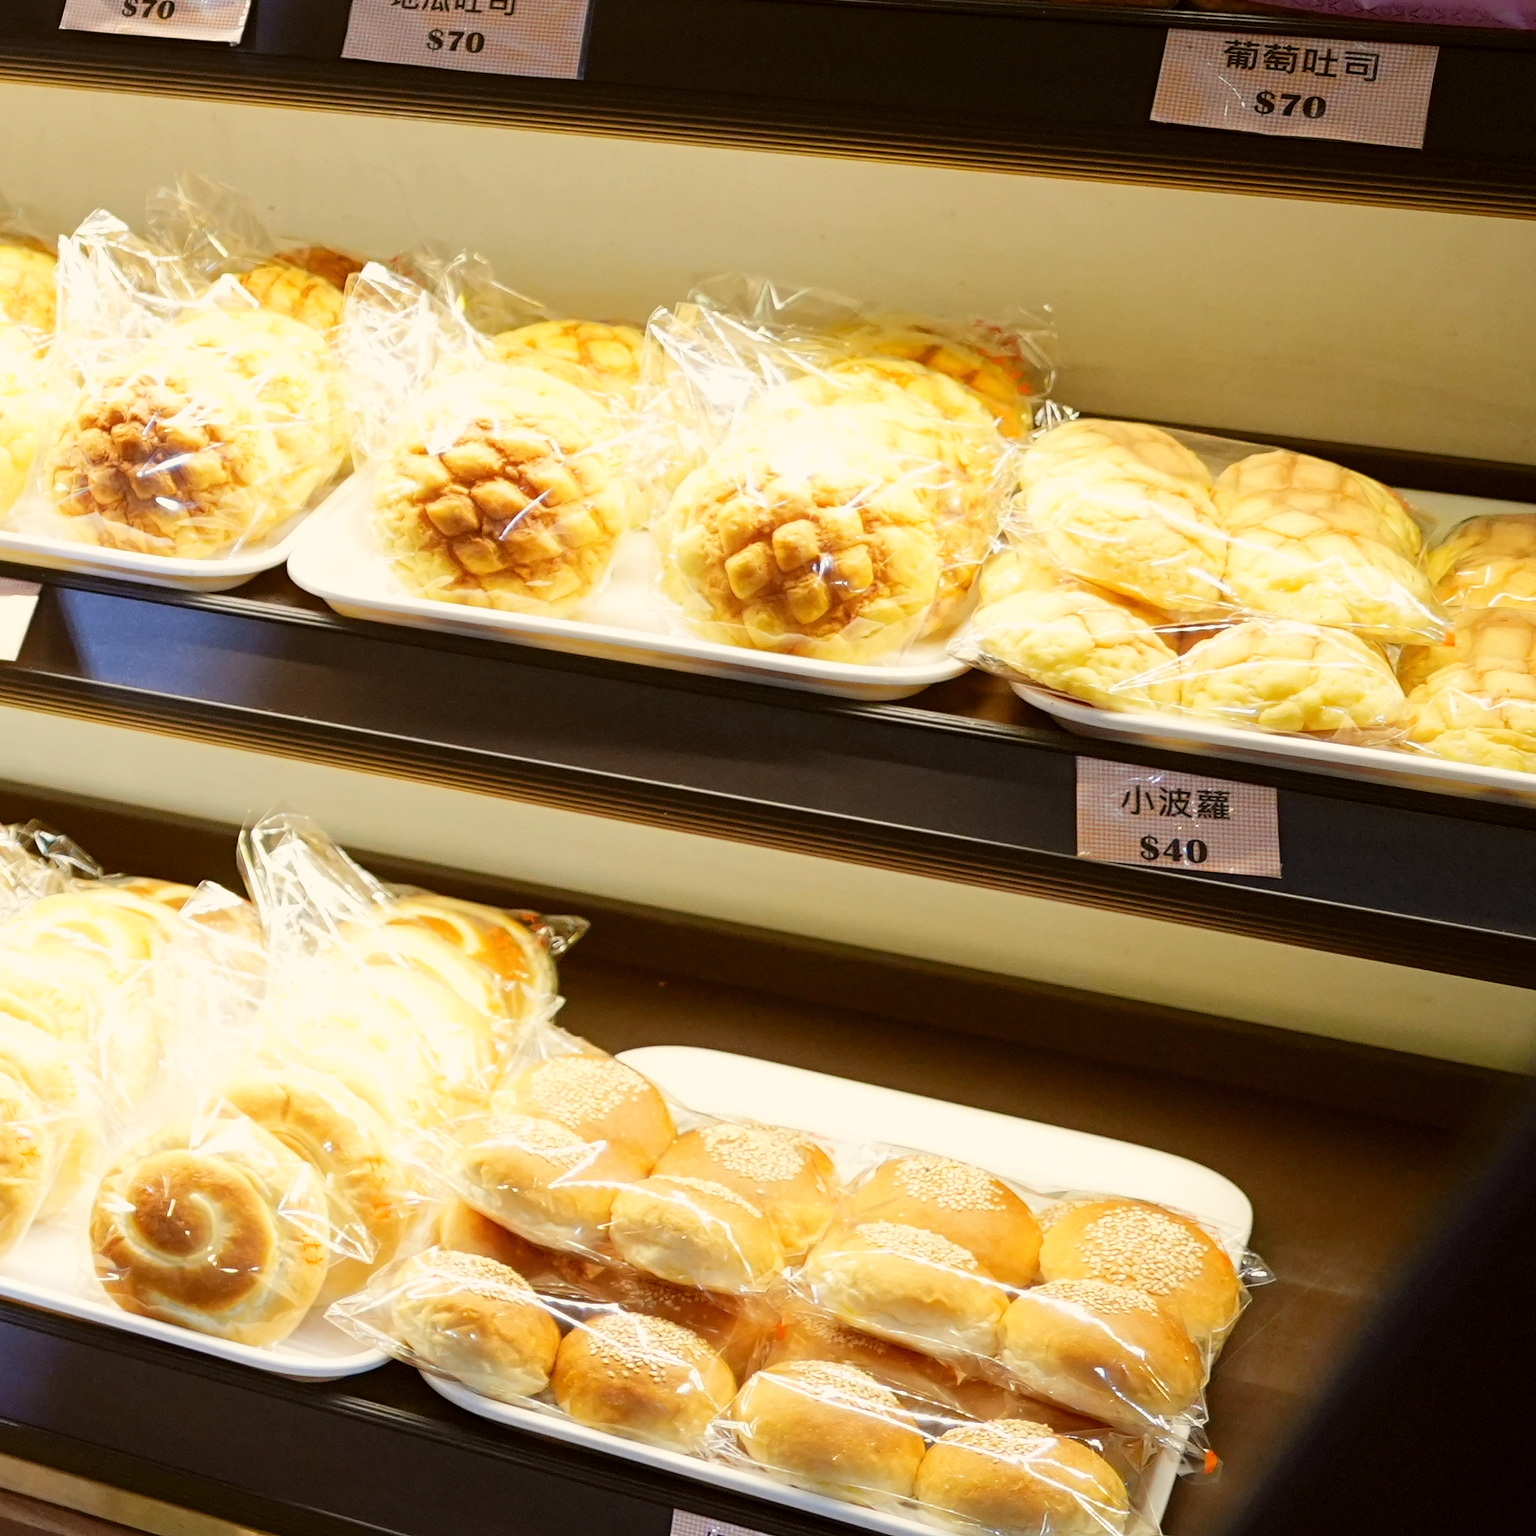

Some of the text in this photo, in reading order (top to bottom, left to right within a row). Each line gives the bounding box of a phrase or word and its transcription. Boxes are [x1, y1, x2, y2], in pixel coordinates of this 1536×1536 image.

[425, 29, 486, 55] $70
[1223, 39, 1381, 82] 葡萄吐司
[1254, 90, 1327, 119] $70
[1121, 784, 1231, 821] 小波蘿
[1139, 834, 1208, 864] $40
